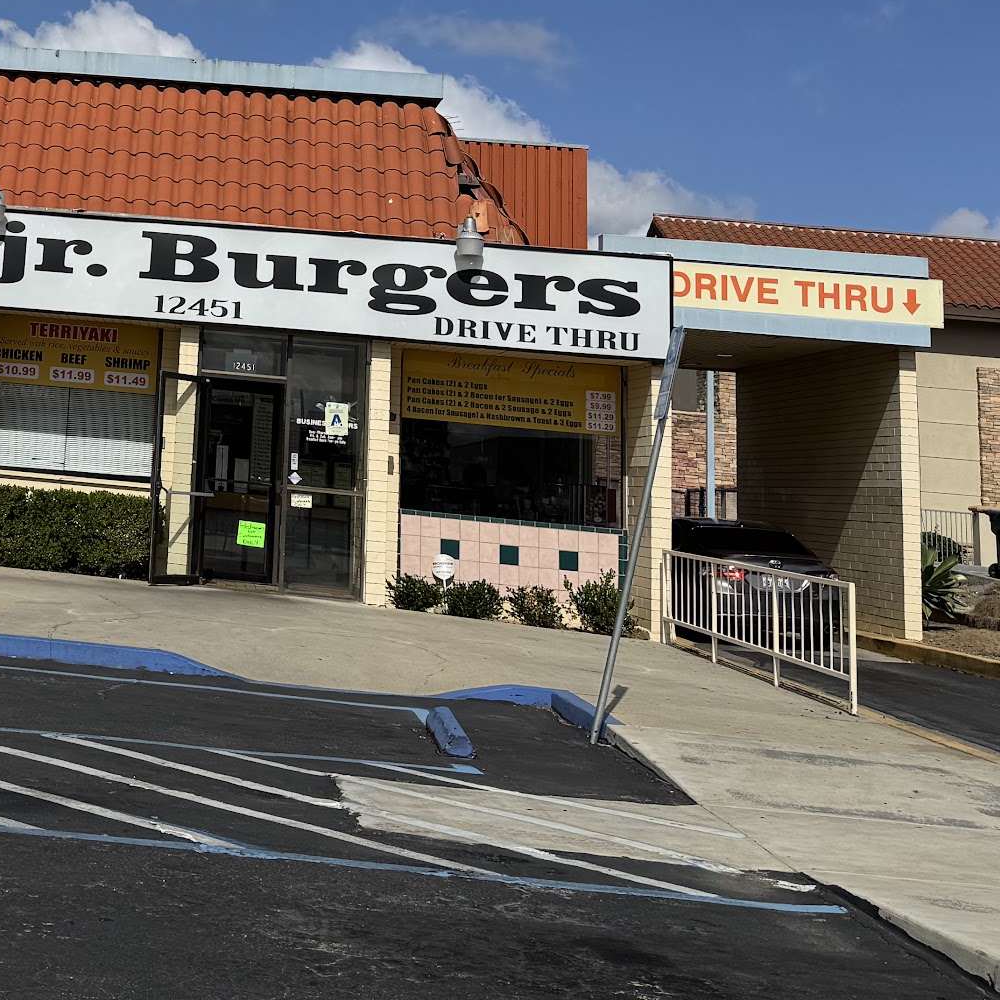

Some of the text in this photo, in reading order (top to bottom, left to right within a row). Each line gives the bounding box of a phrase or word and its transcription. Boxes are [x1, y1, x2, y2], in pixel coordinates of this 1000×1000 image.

[139, 230, 641, 318] Burgers
[673, 271, 893, 314] DRIVE THRU
[154, 295, 243, 320] 12451
[29, 323, 118, 343] TERRIYAKI
[434, 316, 641, 351] DRIVE THRU
[69, 344, 110, 352] vegetables
[61, 353, 86, 365] BEEF
[105, 357, 150, 370] SHRIMP
[233, 362, 255, 371] 12451
[447, 355, 575, 379] Breakfast Specials
[52, 370, 91, 381] $11.99
[107, 374, 146, 386] $11.49
[407, 376, 420, 384] Pan
[422, 378, 444, 386] Cakes
[422, 387, 444, 395] Cakes
[471, 391, 493, 400] Bacon
[590, 392, 612, 400] $7.99
[422, 397, 444, 405] Cakes
[471, 401, 493, 410] Bacon
[412, 406, 434, 414] Bacon
[533, 417, 552, 425] Toast
